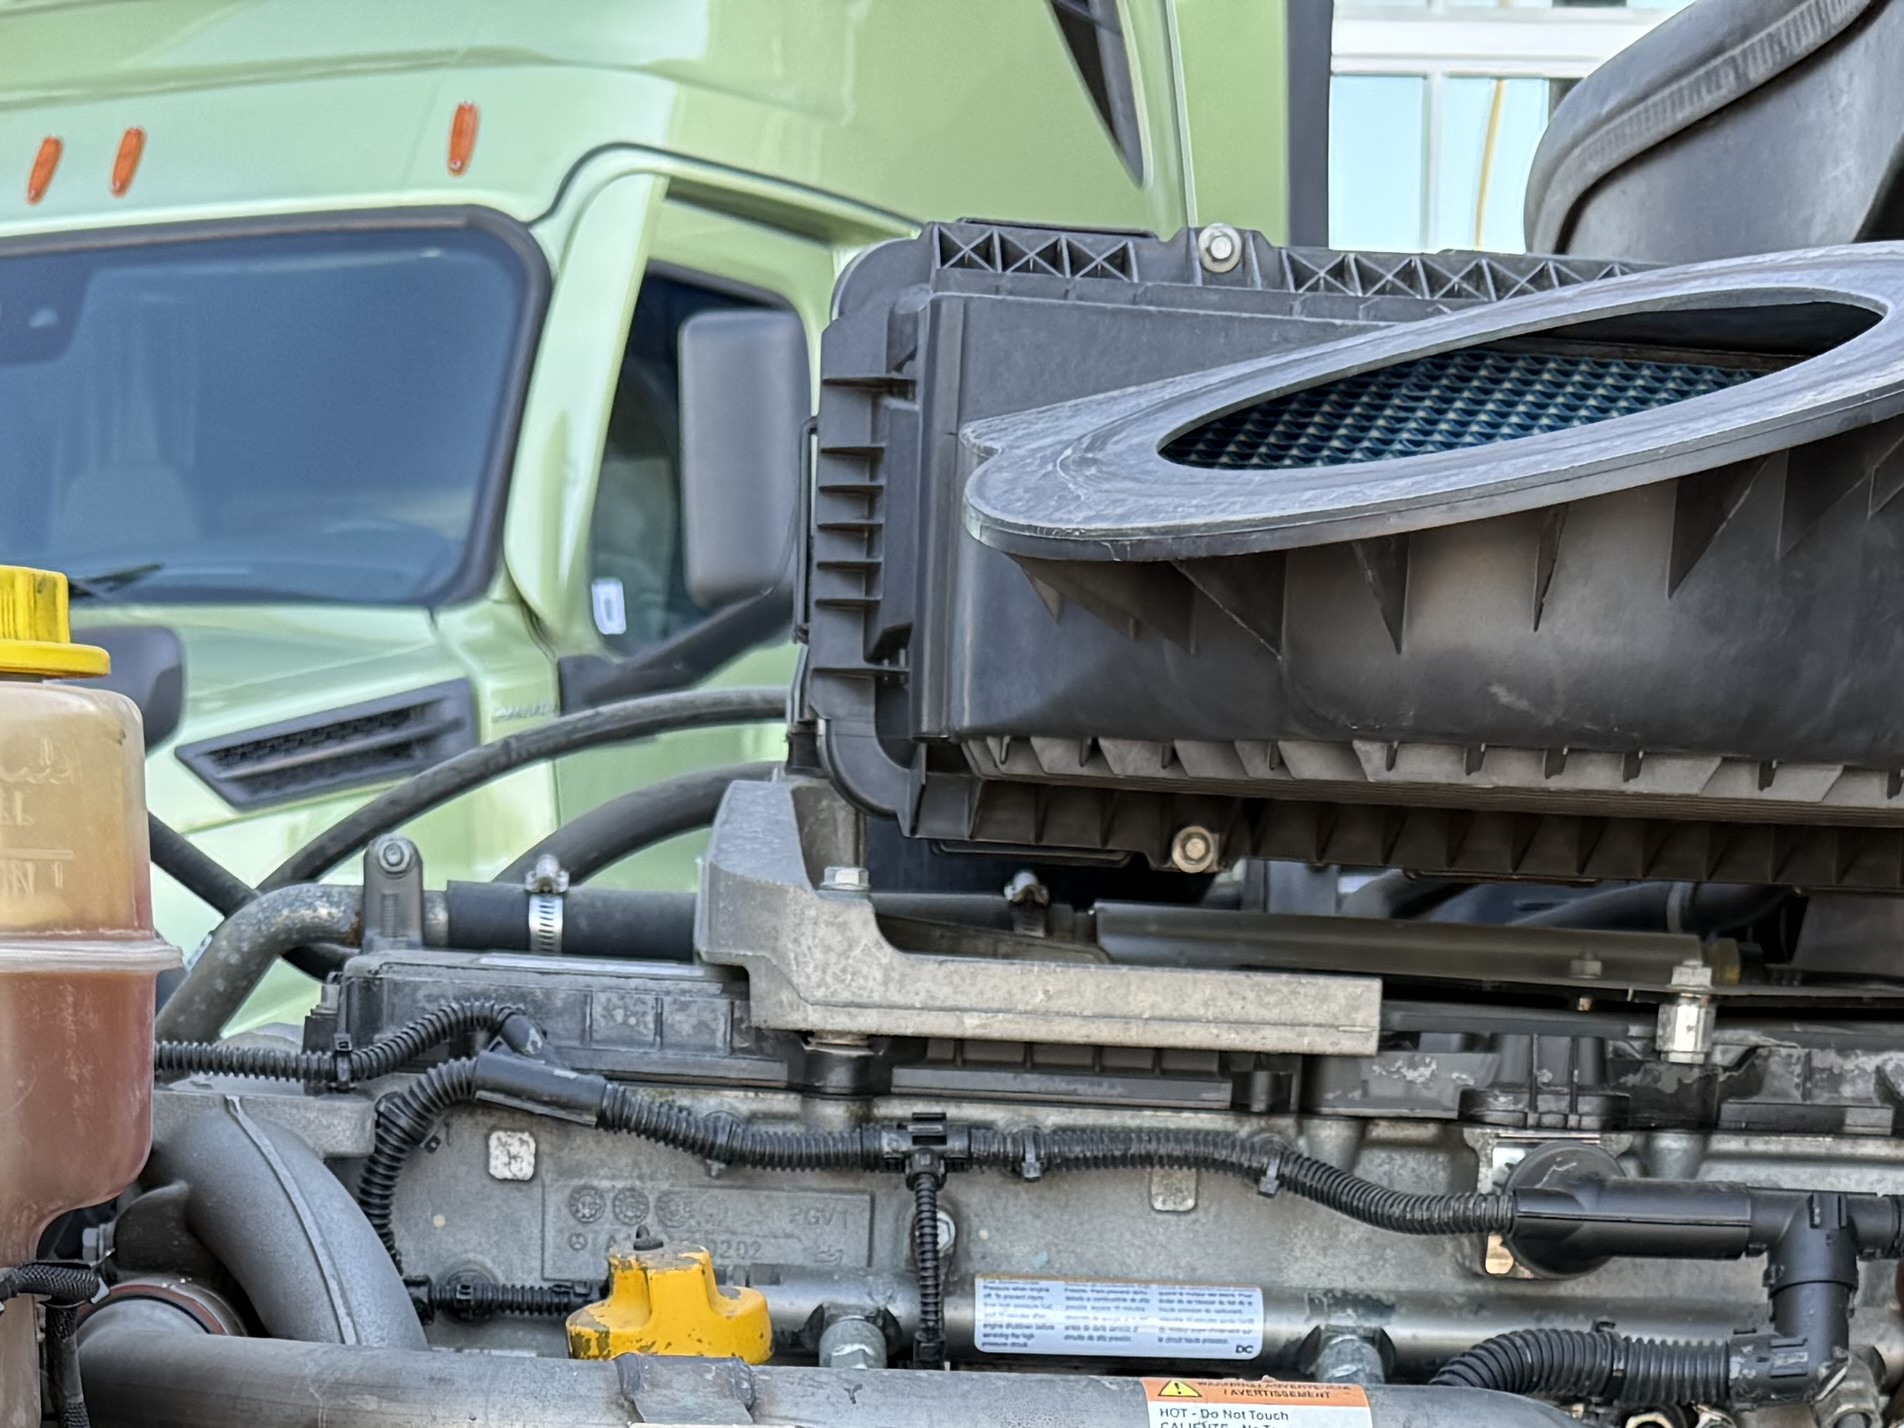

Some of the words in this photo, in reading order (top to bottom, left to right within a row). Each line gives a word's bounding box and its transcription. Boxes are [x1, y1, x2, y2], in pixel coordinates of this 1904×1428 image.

[1235, 1344, 1254, 1354] DC
[1159, 1406, 1188, 1419] HOT
[1199, 1408, 1220, 1421] Do
[1222, 1408, 1247, 1421] Not
[1249, 1409, 1290, 1422] Touch
